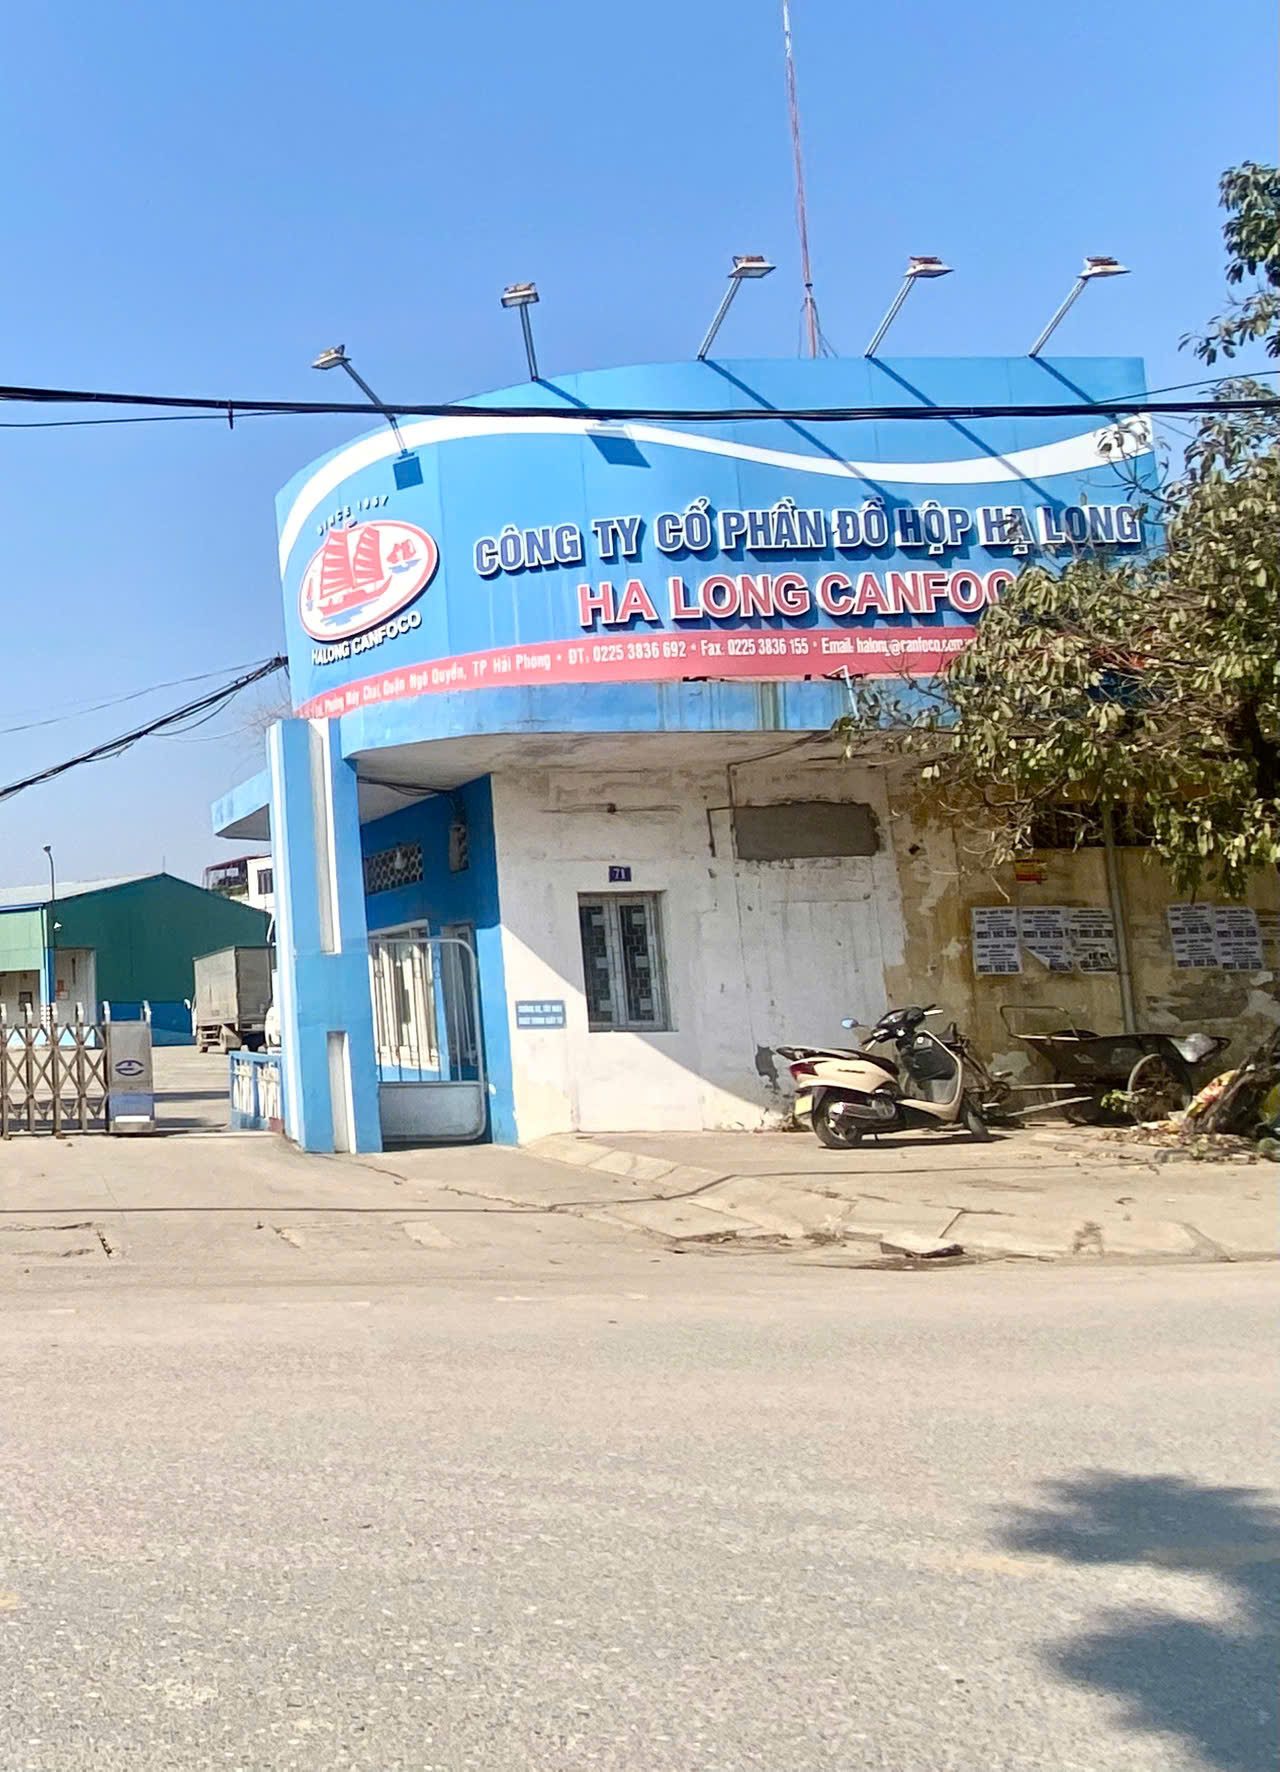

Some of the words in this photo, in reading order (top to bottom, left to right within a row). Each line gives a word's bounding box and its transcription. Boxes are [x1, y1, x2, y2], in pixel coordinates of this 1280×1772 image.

[474, 524, 582, 576] CÔNG
[593, 515, 641, 558] TY
[654, 497, 711, 552] CỔ
[720, 495, 825, 549] PHẦN
[832, 495, 889, 548] ĐỒ
[895, 500, 971, 555] HỘP
[976, 505, 1034, 556] HẠ
[1037, 503, 1141, 545] LONG
[577, 579, 658, 627] HA
[669, 571, 811, 620] LONG
[816, 568, 1017, 617] CANFOC
[311, 640, 352, 665] HALONG
[351, 611, 422, 655] CANFOCO
[472, 658, 488, 678] TP
[593, 644, 624, 662] 0225
[626, 642, 660, 660] 3836
[663, 640, 687, 658] 692
[727, 638, 756, 656] 0225
[757, 637, 787, 655] 3836
[789, 637, 809, 655] 155
[612, 867, 627, 880] 71
